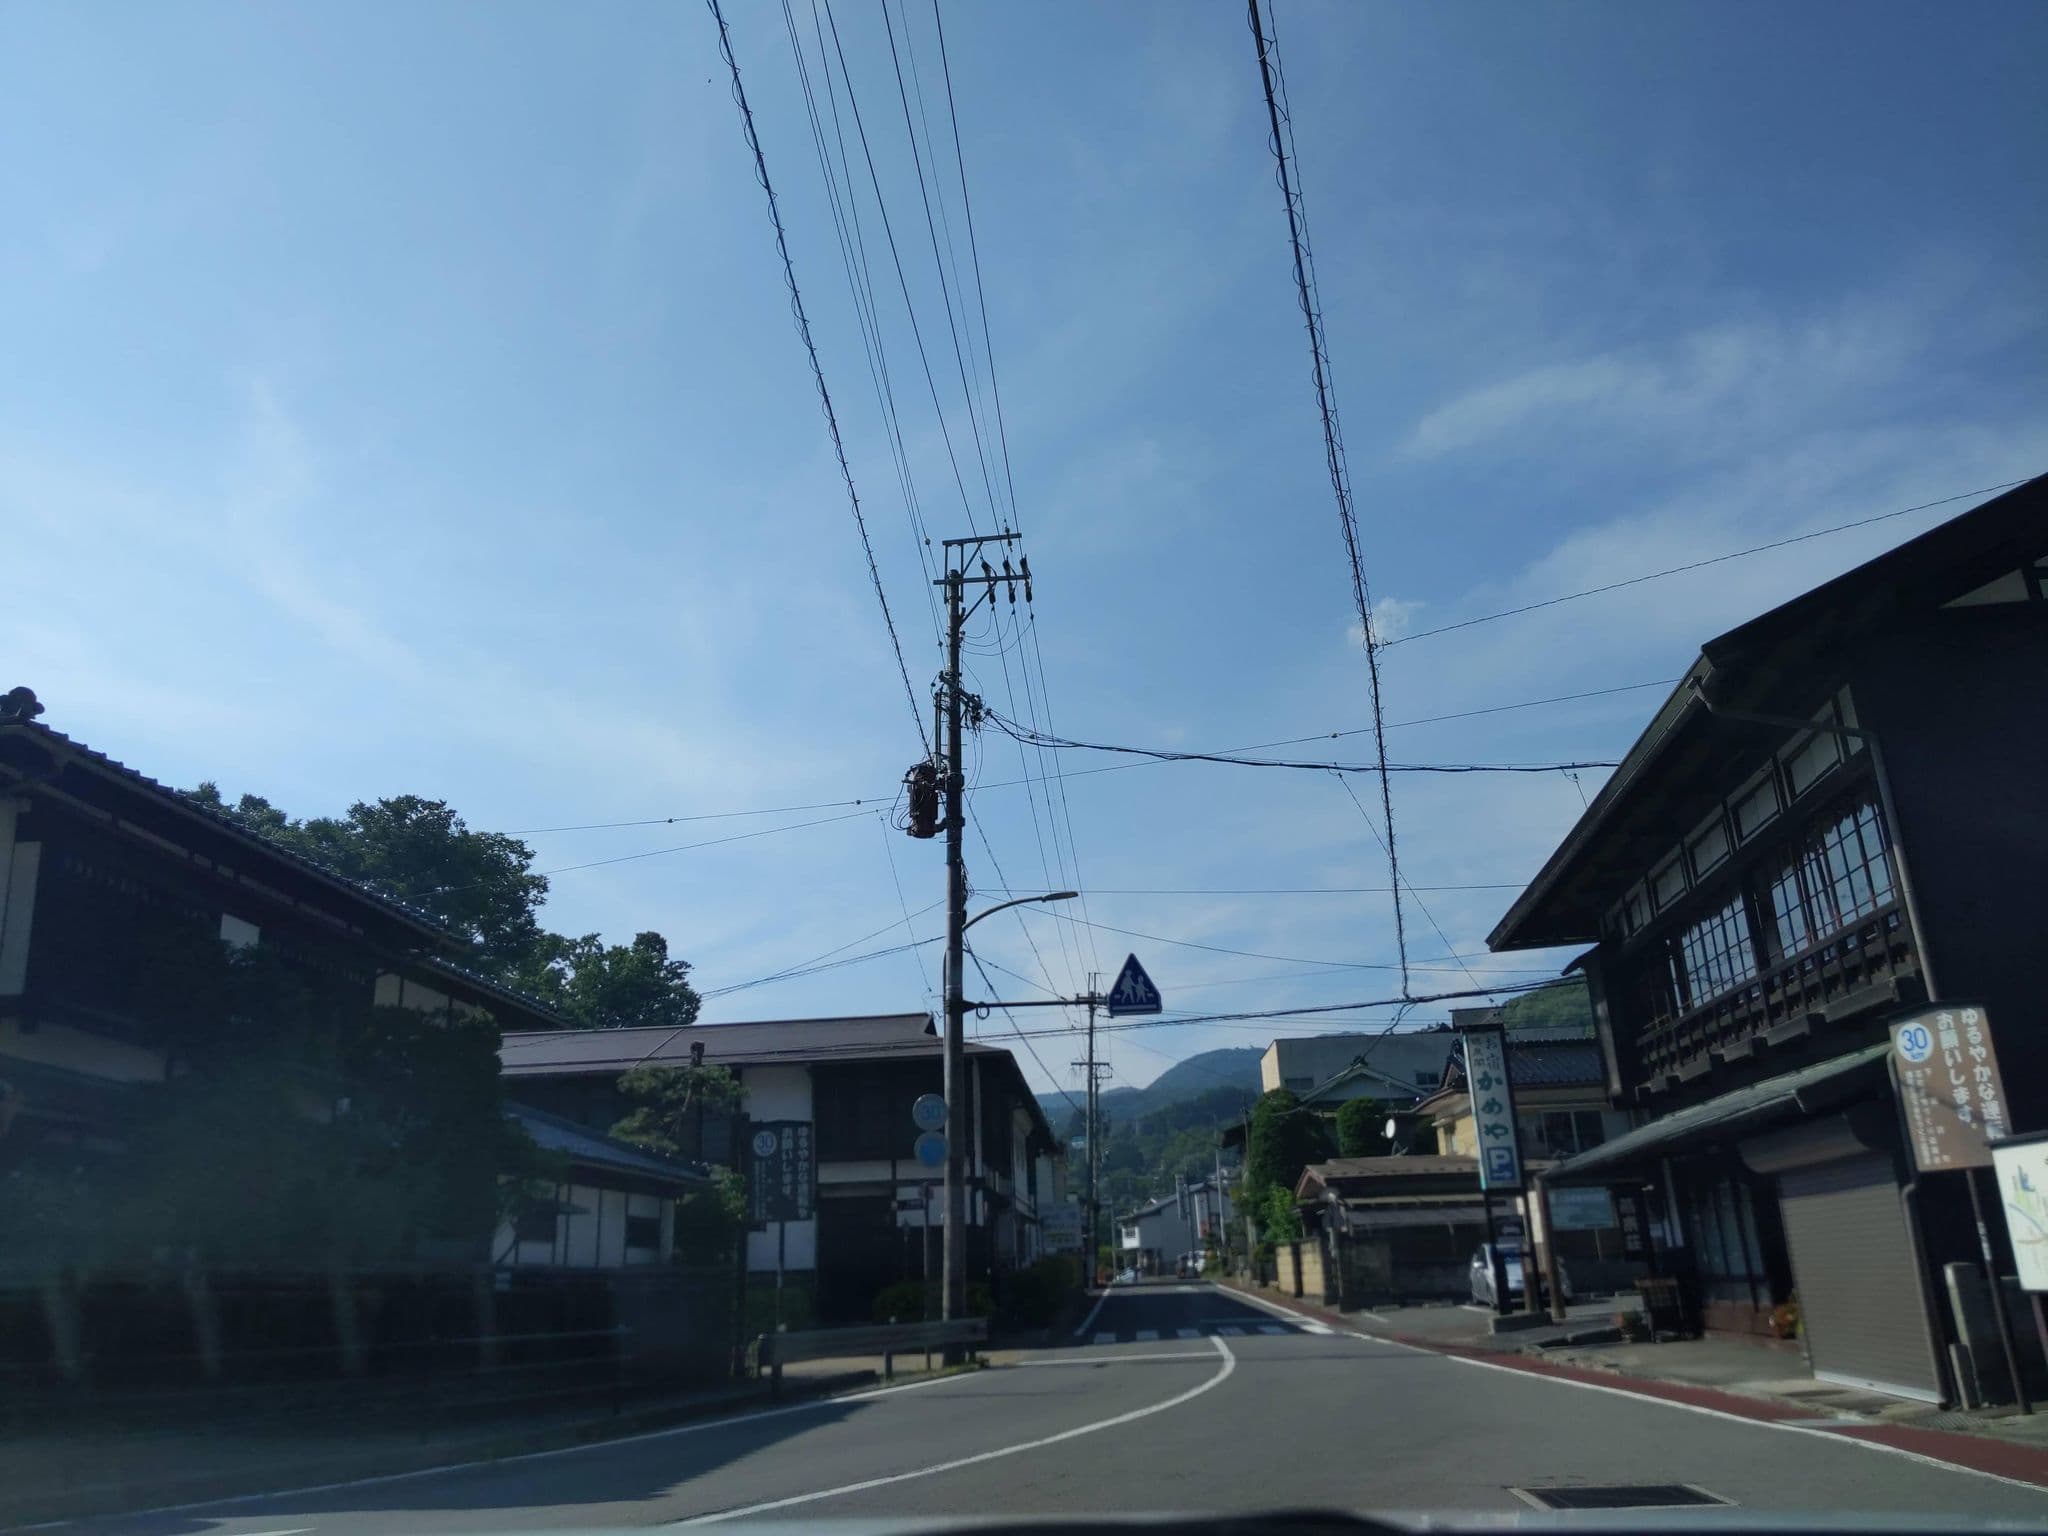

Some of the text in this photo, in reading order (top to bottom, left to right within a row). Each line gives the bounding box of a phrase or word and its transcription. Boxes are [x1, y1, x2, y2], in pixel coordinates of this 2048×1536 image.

[1901, 1027, 1928, 1052] 30
[1477, 1069, 1509, 1140] かめや
[1490, 1150, 1510, 1172] P
